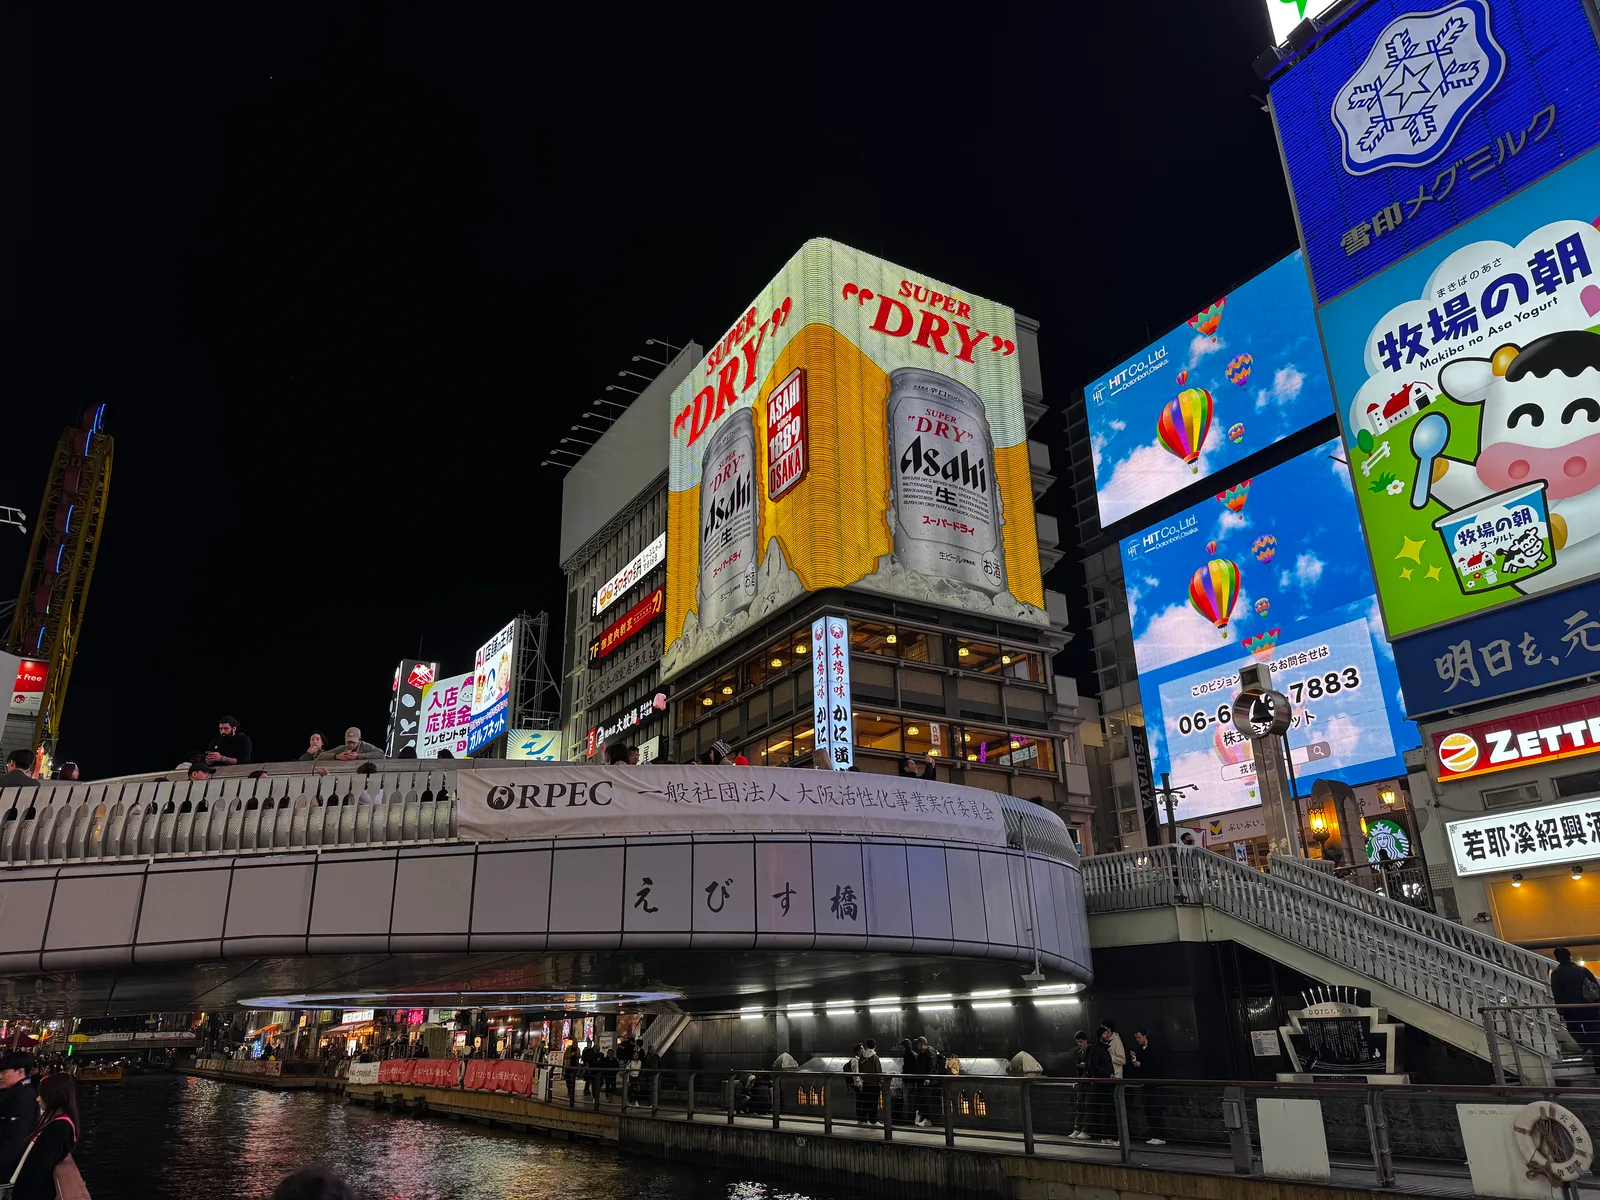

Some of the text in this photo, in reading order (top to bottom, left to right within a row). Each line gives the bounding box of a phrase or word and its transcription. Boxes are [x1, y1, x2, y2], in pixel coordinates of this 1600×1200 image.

[1340, 104, 1557, 257] 雪印メグミルク
[1436, 257, 1503, 298] まきばのあさ
[899, 279, 971, 320] SUPER
[1377, 231, 1593, 373] 牧場の朝
[706, 306, 757, 377] SUPER
[1419, 296, 1558, 371] Makiba no Asa Yogurt
[1109, 369, 1128, 390] HIT
[769, 376, 800, 429] ASAHI
[925, 408, 957, 424] SUPER
[769, 416, 800, 464] 1889
[770, 446, 801, 494] OSAKA
[901, 435, 987, 494] Asahi
[704, 470, 751, 544] Asahi
[935, 486, 958, 507] 生
[721, 527, 733, 548] 生
[922, 515, 975, 536] スーパードライ
[1142, 530, 1160, 547] HIT
[1458, 507, 1533, 547] 牧場の朝
[1479, 532, 1515, 549] ヨーグルト
[590, 642, 599, 661] 7F
[816, 645, 825, 699] 本場の味
[24, 673, 42, 682] Free
[425, 705, 471, 734] 応援金
[428, 687, 458, 712] 入店
[831, 643, 850, 772] 本場の味 かに道
[469, 713, 505, 751] ガルフネット
[1133, 734, 1153, 809] TSUTAYA
[638, 781, 995, 822] 一般社団法人 大阪活性化事業実行委員会
[634, 877, 858, 921] えびす橋
